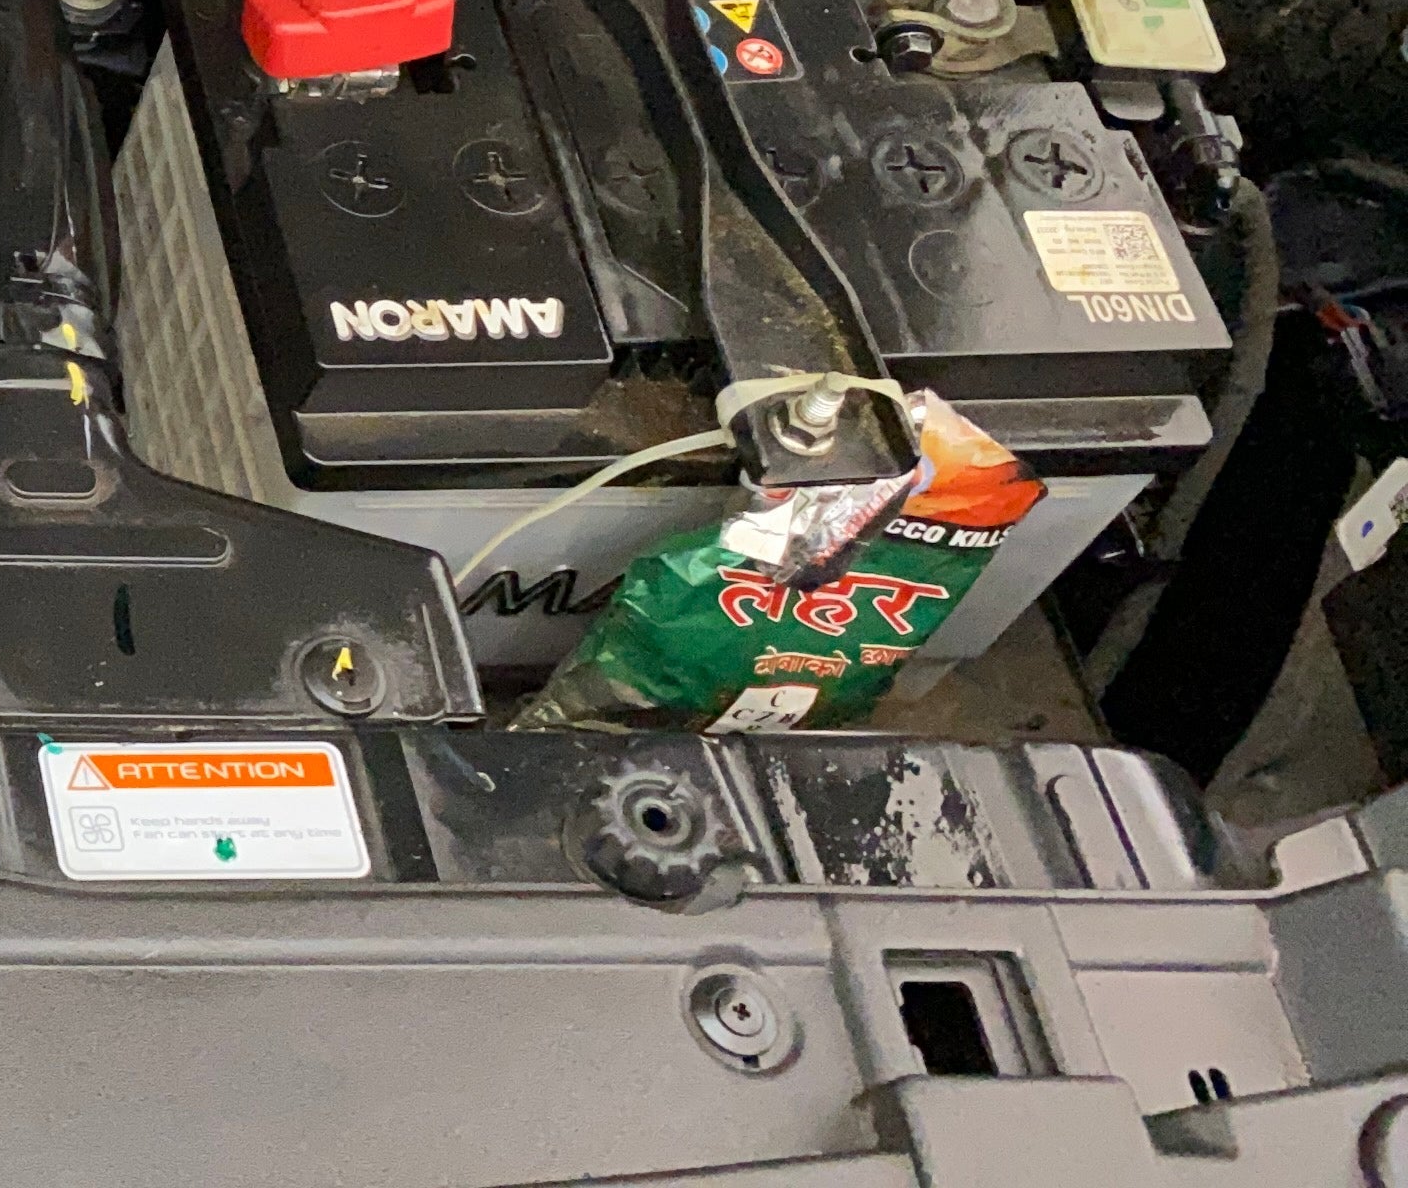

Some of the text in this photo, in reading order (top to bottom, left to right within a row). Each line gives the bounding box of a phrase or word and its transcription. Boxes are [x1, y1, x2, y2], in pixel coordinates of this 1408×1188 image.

[329, 297, 565, 342] AMARON
[1066, 293, 1197, 323] DIN60L
[117, 761, 306, 780] ATTENTION
[174, 816, 224, 826] hands
